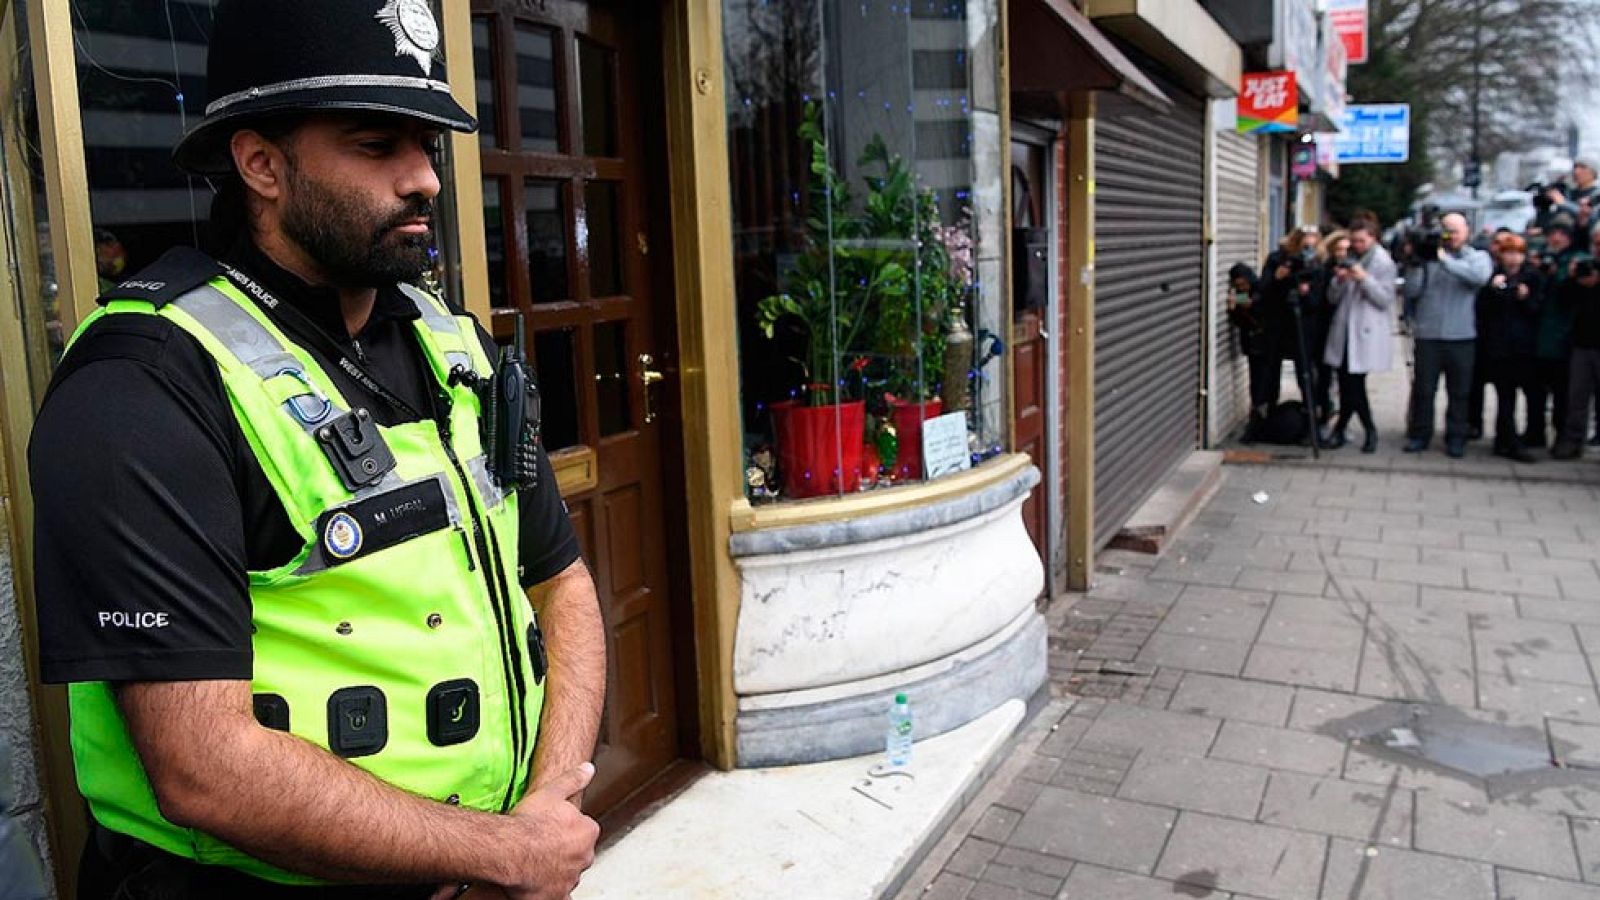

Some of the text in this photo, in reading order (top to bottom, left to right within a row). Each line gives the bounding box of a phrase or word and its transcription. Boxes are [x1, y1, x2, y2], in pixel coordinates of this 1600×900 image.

[1244, 76, 1288, 98] JUST
[1253, 90, 1288, 110] EAT
[247, 282, 279, 309] POLICE
[339, 357, 365, 379] WEST
[97, 611, 169, 628] POLICE
